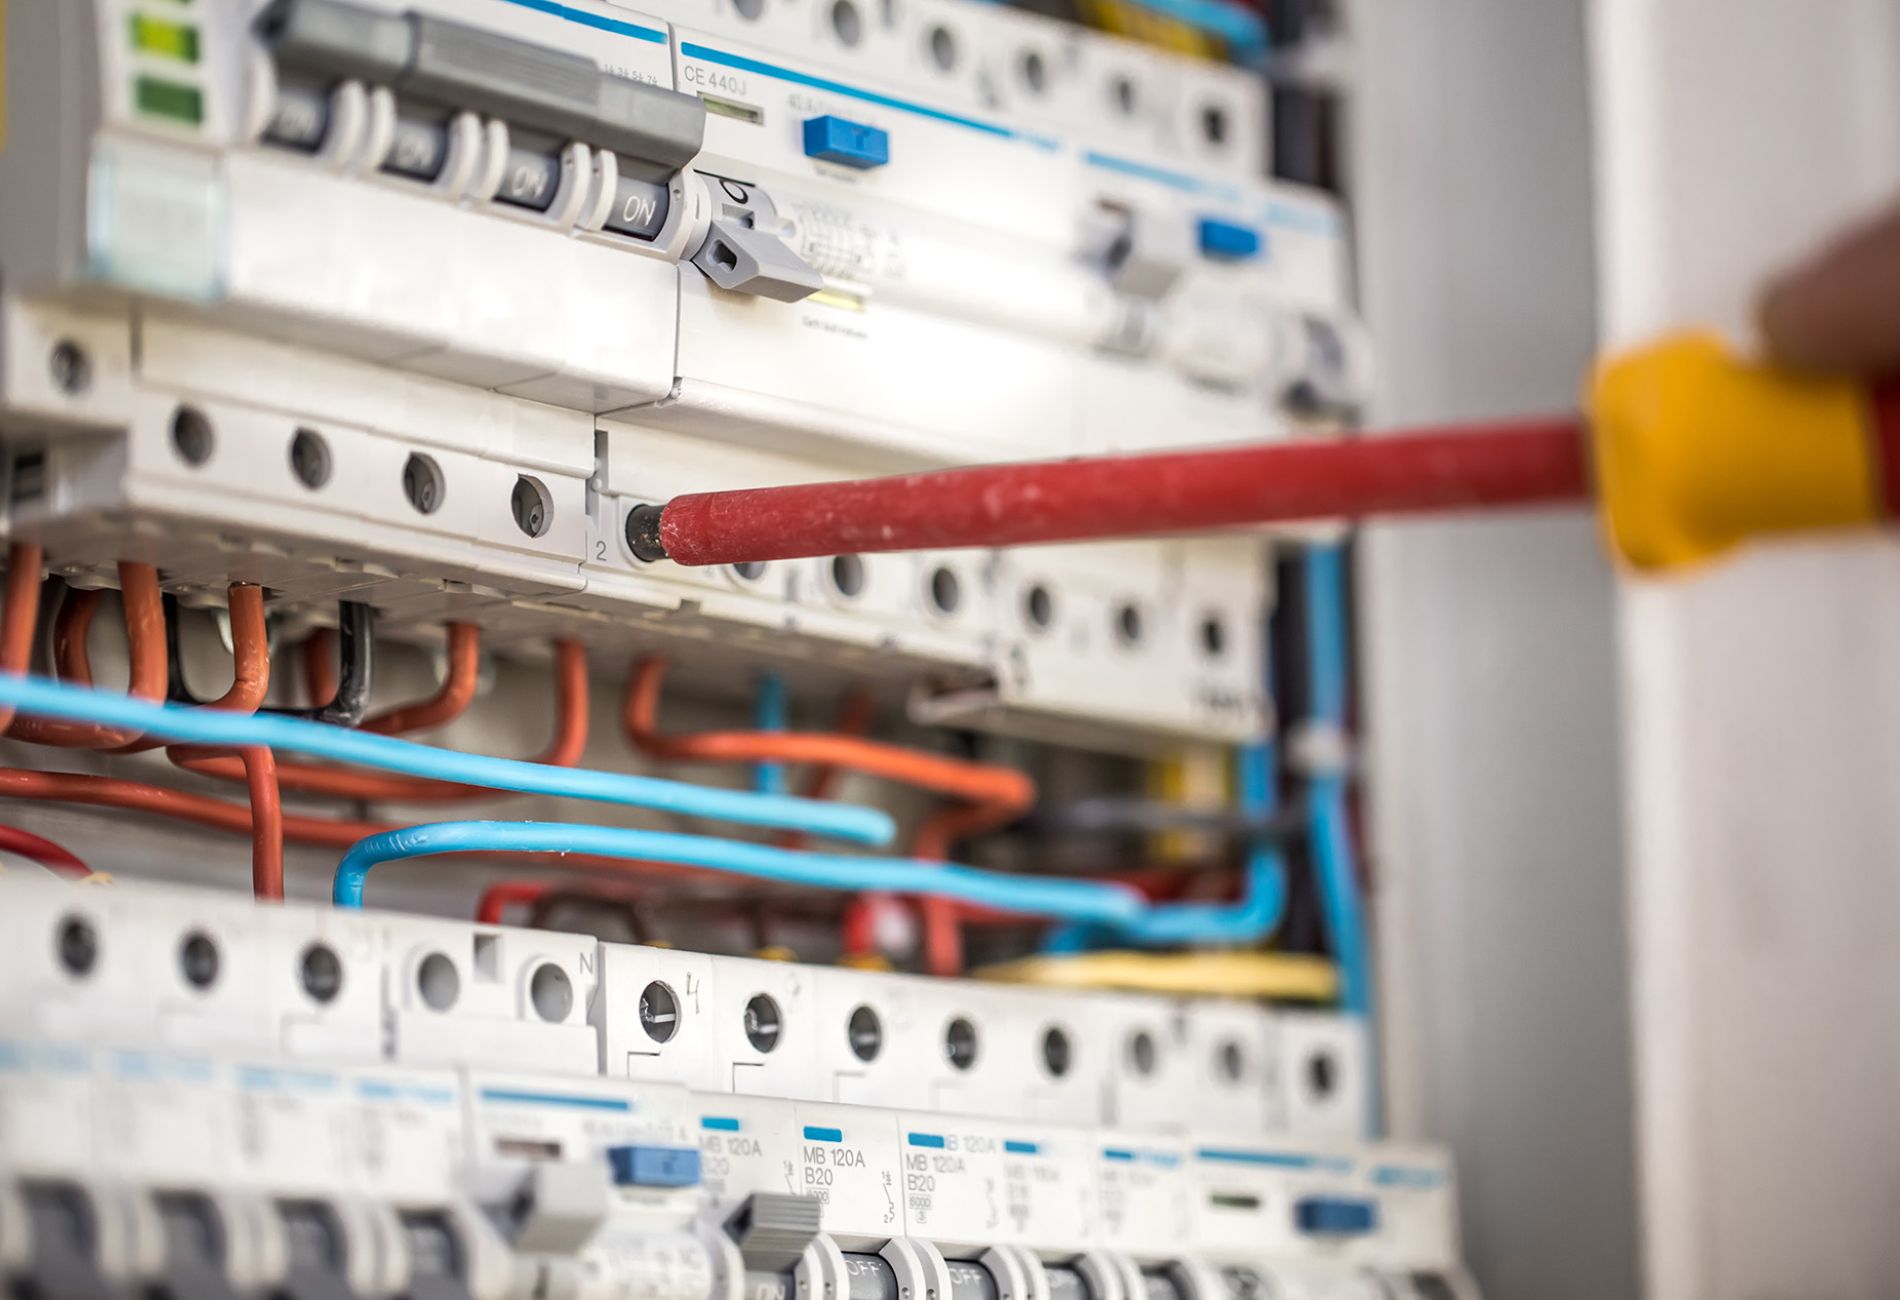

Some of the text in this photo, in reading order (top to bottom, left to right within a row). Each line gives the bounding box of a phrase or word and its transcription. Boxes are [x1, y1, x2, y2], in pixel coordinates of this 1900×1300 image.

[684, 65, 705, 86] CE
[511, 165, 548, 199] ON
[623, 195, 656, 227] ON
[596, 540, 607, 562] 2
[580, 951, 594, 975] N
[685, 971, 700, 1015] 4
[727, 1136, 763, 1158] 120A
[803, 1146, 866, 1168] MB 120A
[906, 1154, 966, 1174] MB 120A
[804, 1166, 834, 1186] B20
[907, 1173, 935, 1192] B20
[845, 1260, 881, 1277] OFF
[950, 1268, 983, 1285] OFF
